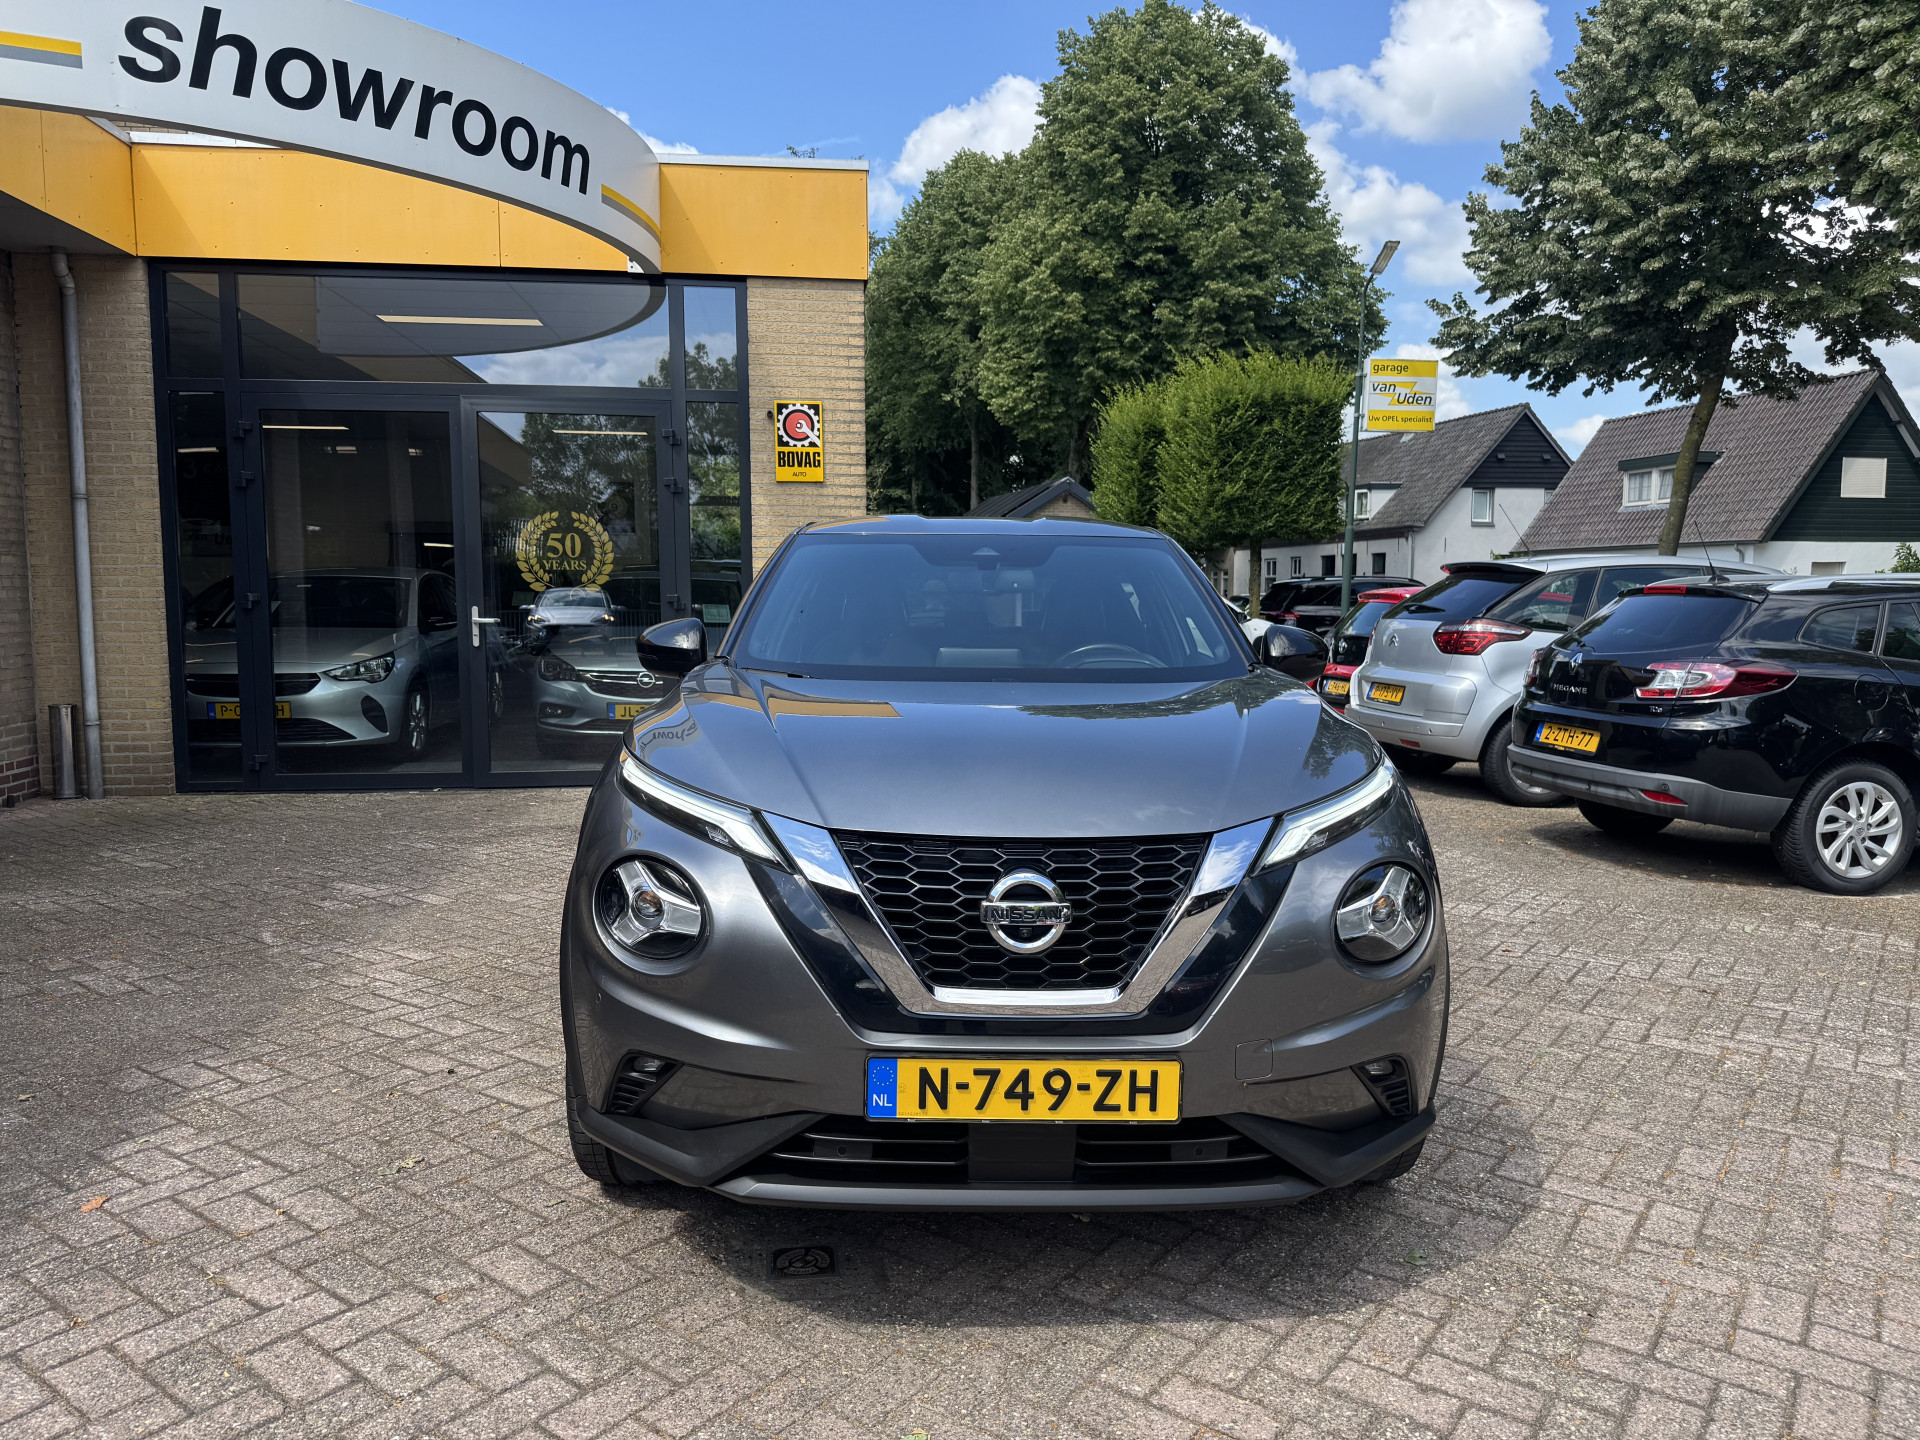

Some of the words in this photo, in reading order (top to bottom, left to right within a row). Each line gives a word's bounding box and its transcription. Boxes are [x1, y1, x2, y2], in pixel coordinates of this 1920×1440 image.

[118, 6, 590, 195] showroom
[1373, 364, 1409, 374] garage
[1372, 383, 1396, 392] van
[1397, 392, 1432, 405] Uden
[1401, 416, 1432, 424] specialist
[778, 451, 821, 468] BOVAG
[546, 532, 582, 558] 50
[542, 560, 587, 571] YEARS
[1544, 726, 1594, 748] 2-ZTH-77
[989, 906, 1060, 921] NISSAN
[872, 1093, 893, 1107] NL
[918, 1066, 1159, 1112] N-749-ZH
